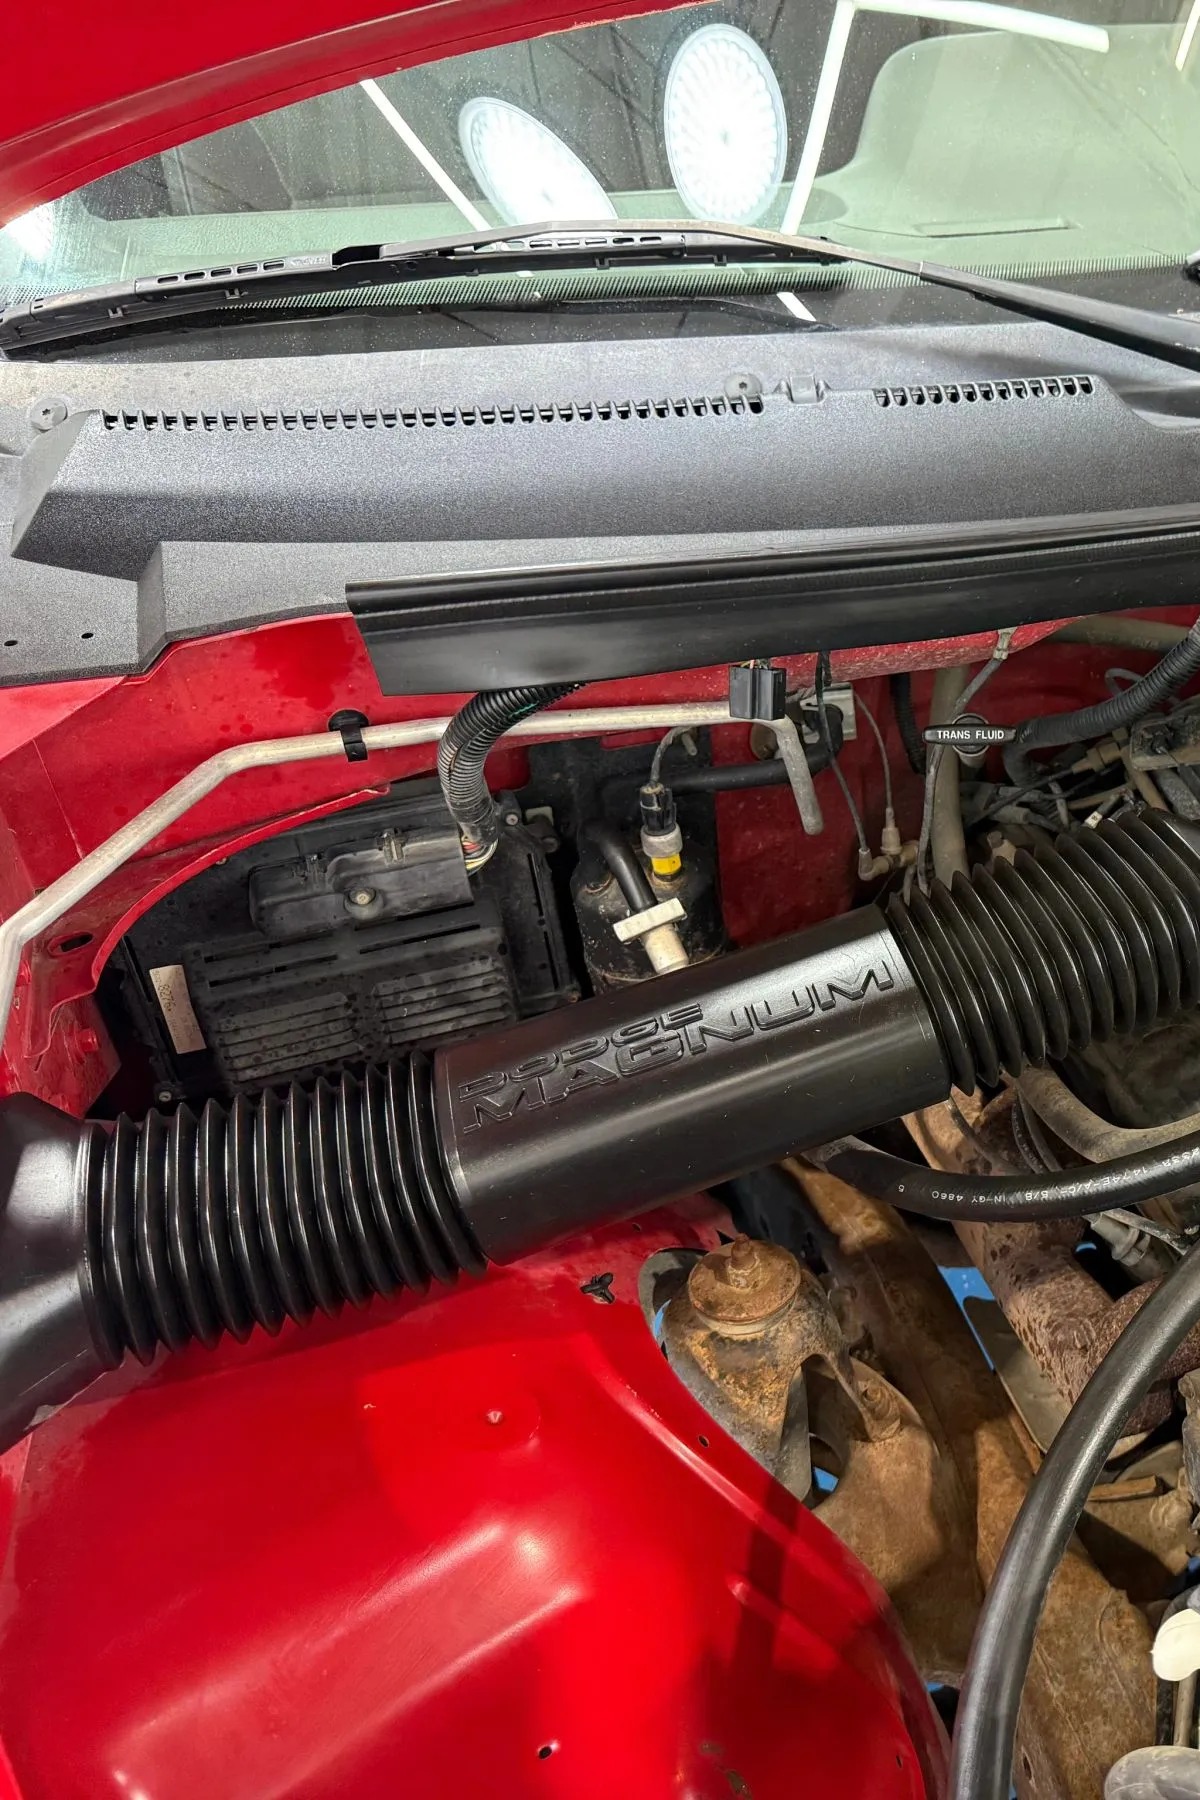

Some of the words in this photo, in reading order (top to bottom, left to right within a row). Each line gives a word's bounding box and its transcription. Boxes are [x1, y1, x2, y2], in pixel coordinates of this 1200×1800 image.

[937, 730, 970, 740] TRANS
[975, 730, 1004, 740] FLUID
[458, 1002, 703, 1102] DODGE
[463, 960, 894, 1133] MAGNUM
